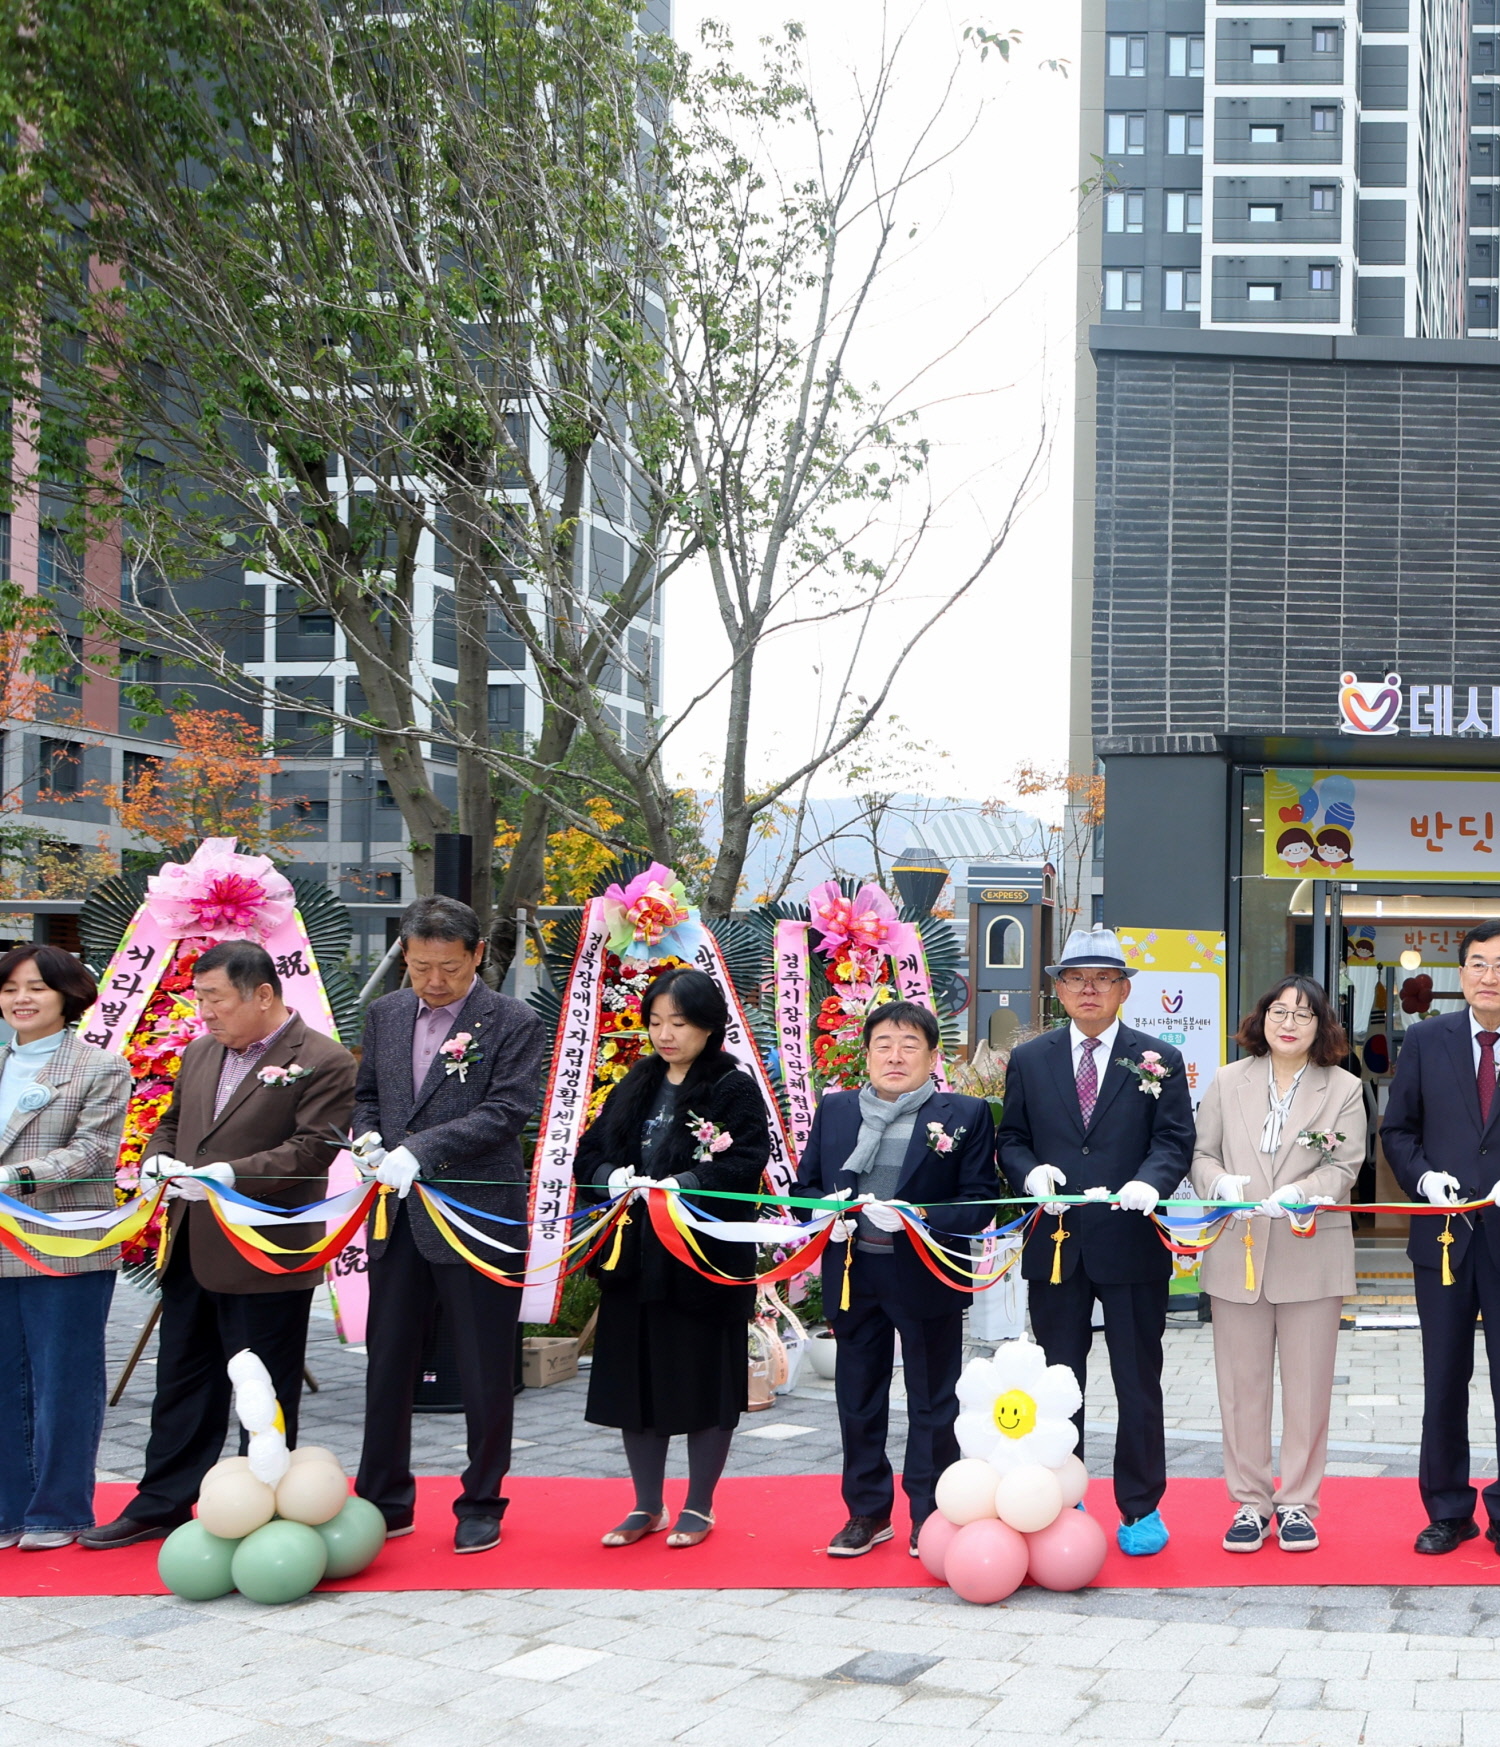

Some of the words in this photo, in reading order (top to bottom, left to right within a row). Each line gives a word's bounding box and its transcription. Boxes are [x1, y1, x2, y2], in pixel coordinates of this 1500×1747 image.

[987, 891, 1023, 900] EXPRESS
[83, 945, 156, 1050] 서라벌여
[899, 954, 927, 1008] 개소
[545, 932, 603, 1166] 경북장애인자립생활센터장
[781, 953, 812, 1156] 경주시장애인단체협의회
[1134, 1017, 1155, 1028] 경주시
[1158, 1016, 1211, 1031] 다함께돌봄센터
